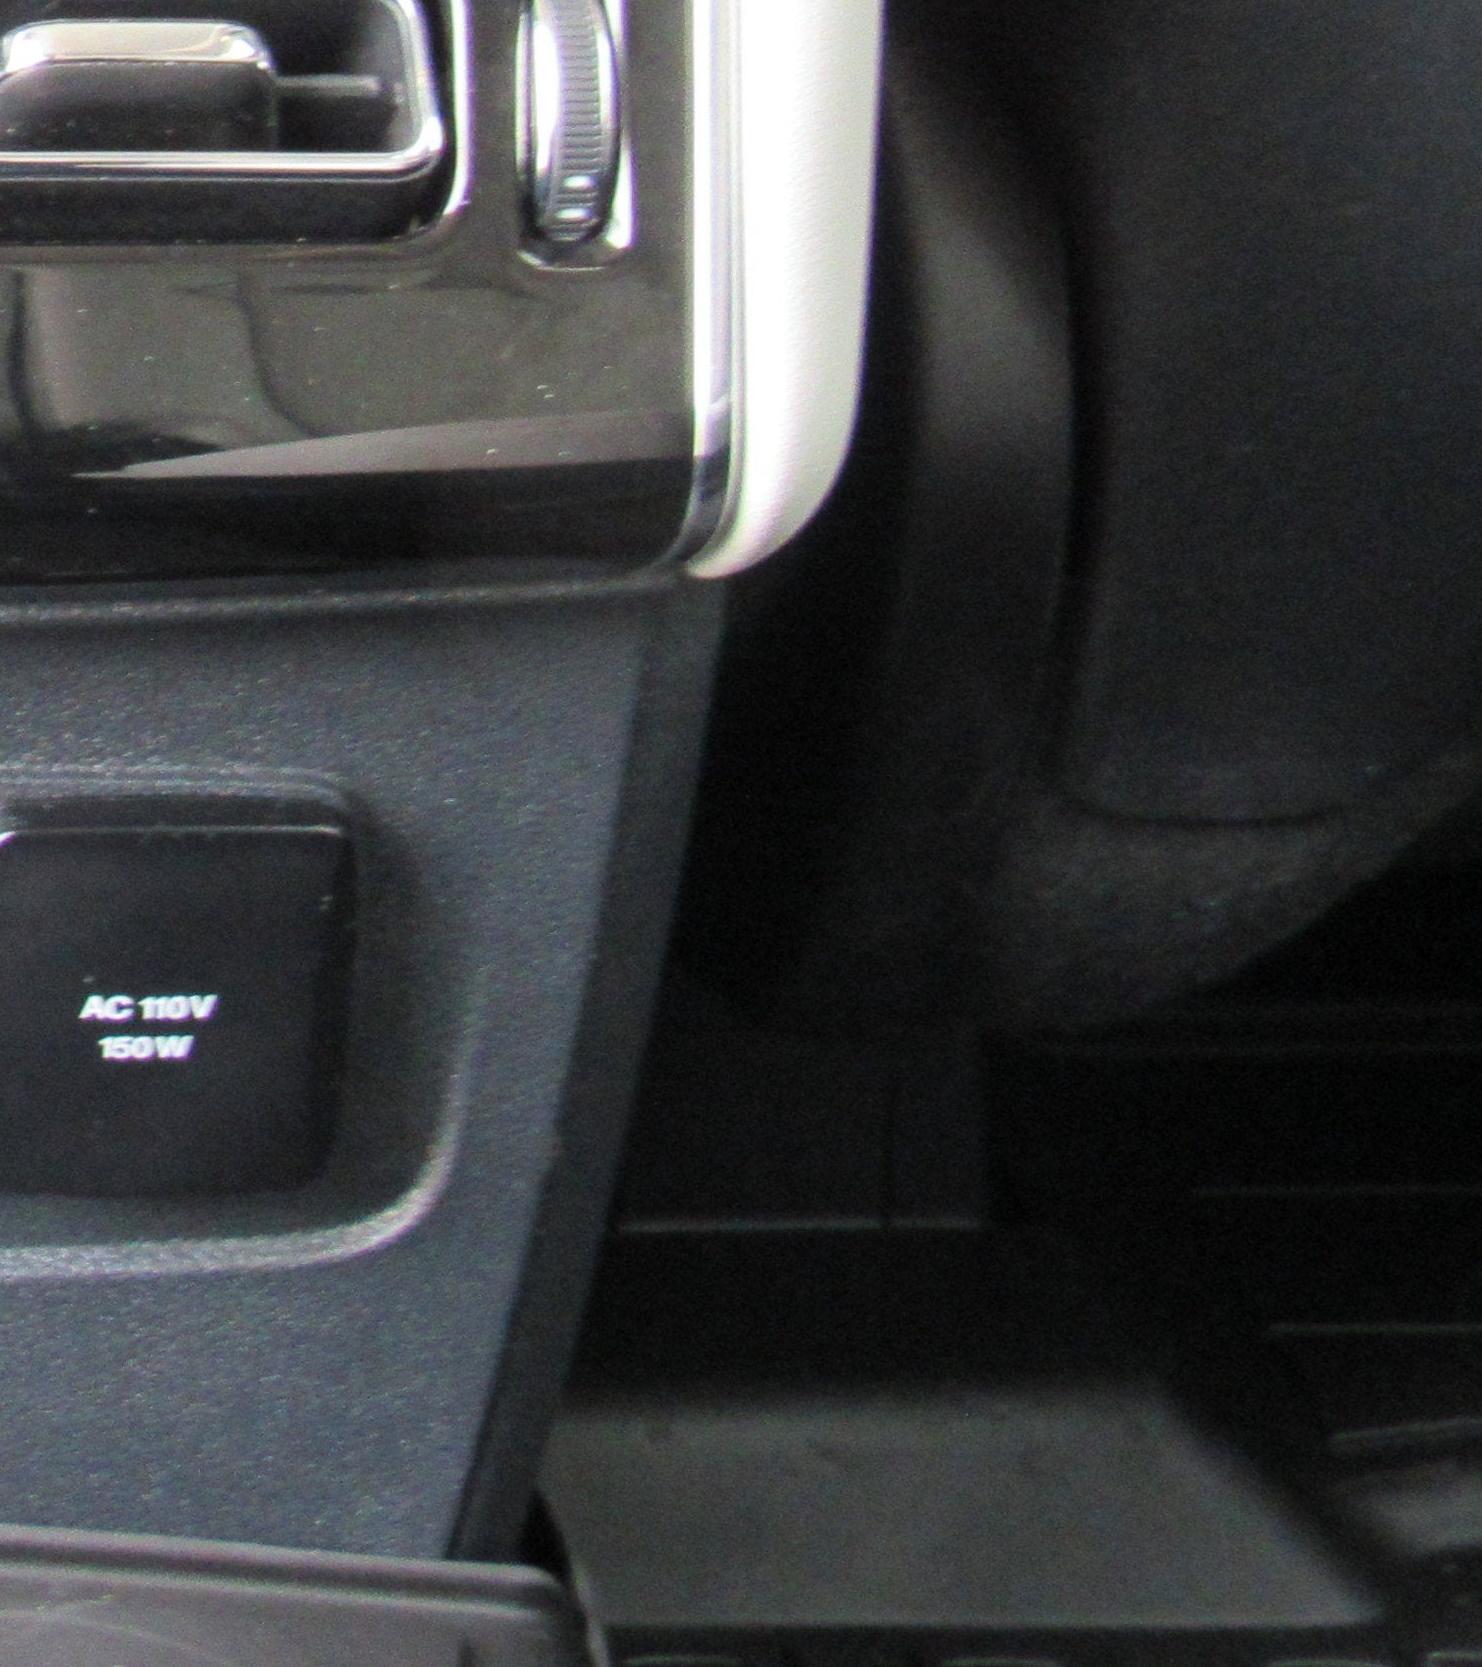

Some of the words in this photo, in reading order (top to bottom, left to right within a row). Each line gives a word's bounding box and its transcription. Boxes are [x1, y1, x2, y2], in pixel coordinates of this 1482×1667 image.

[78, 994, 134, 1021] AC
[137, 993, 219, 1021] 110V
[97, 1034, 195, 1060] 150W
